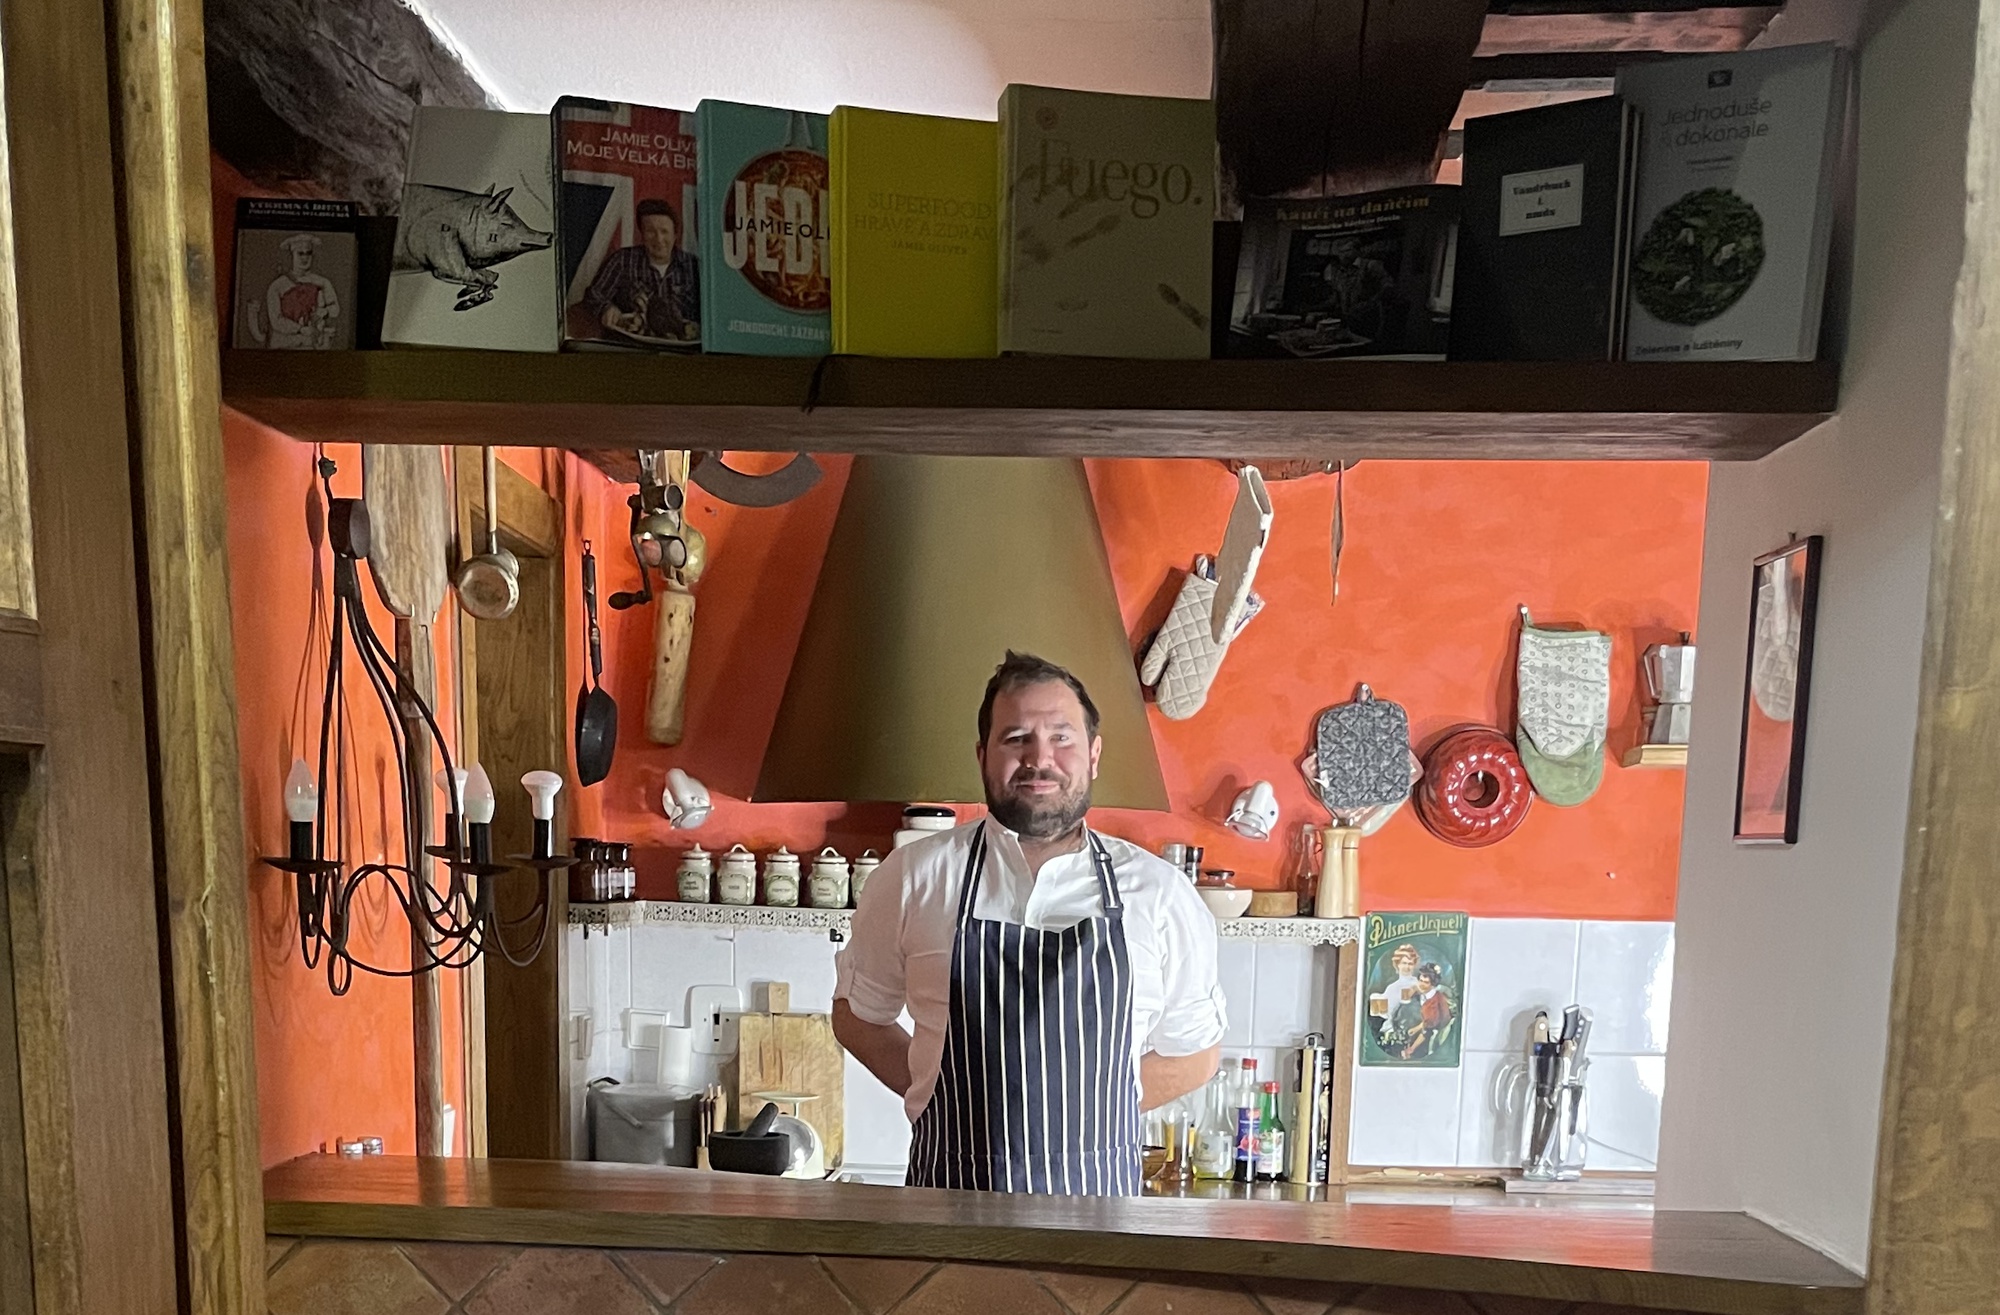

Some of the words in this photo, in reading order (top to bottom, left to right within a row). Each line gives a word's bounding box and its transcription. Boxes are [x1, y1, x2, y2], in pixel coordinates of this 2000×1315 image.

[1661, 97, 1773, 127] Jednoduše
[601, 127, 650, 148] JAMIE
[653, 134, 697, 154] OLIV
[1675, 121, 1769, 147] dokonale
[566, 140, 615, 159] MOJE
[616, 146, 670, 168] VELKÁ
[735, 217, 794, 236] JAMIE
[1369, 914, 1419, 947] Pilsner
[1419, 913, 1463, 938] Urquell
